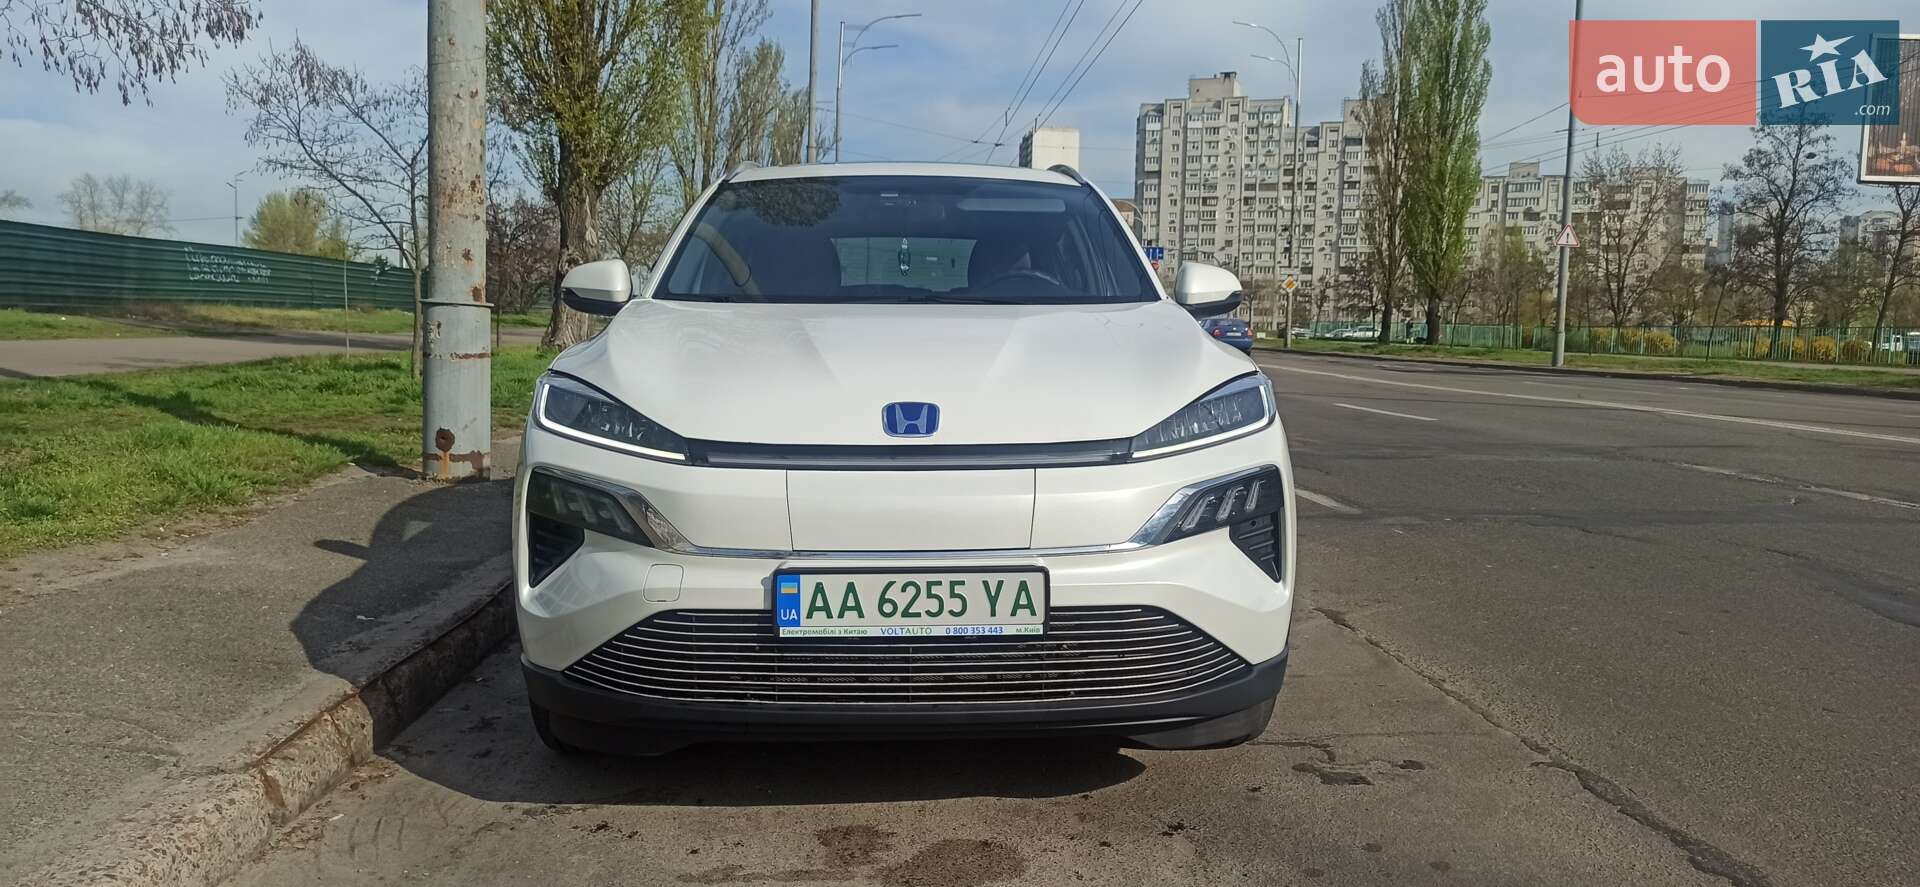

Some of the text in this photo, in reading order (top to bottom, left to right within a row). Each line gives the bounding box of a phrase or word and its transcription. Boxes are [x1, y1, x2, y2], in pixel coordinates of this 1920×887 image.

[806, 579, 1038, 619] AA 6255 YA
[780, 609, 798, 621] UA
[782, 628, 837, 636] Електромобілі
[844, 628, 868, 636] Китаю
[880, 627, 933, 636] VOLTAUTO
[945, 626, 1004, 635] 0 800 353 443
